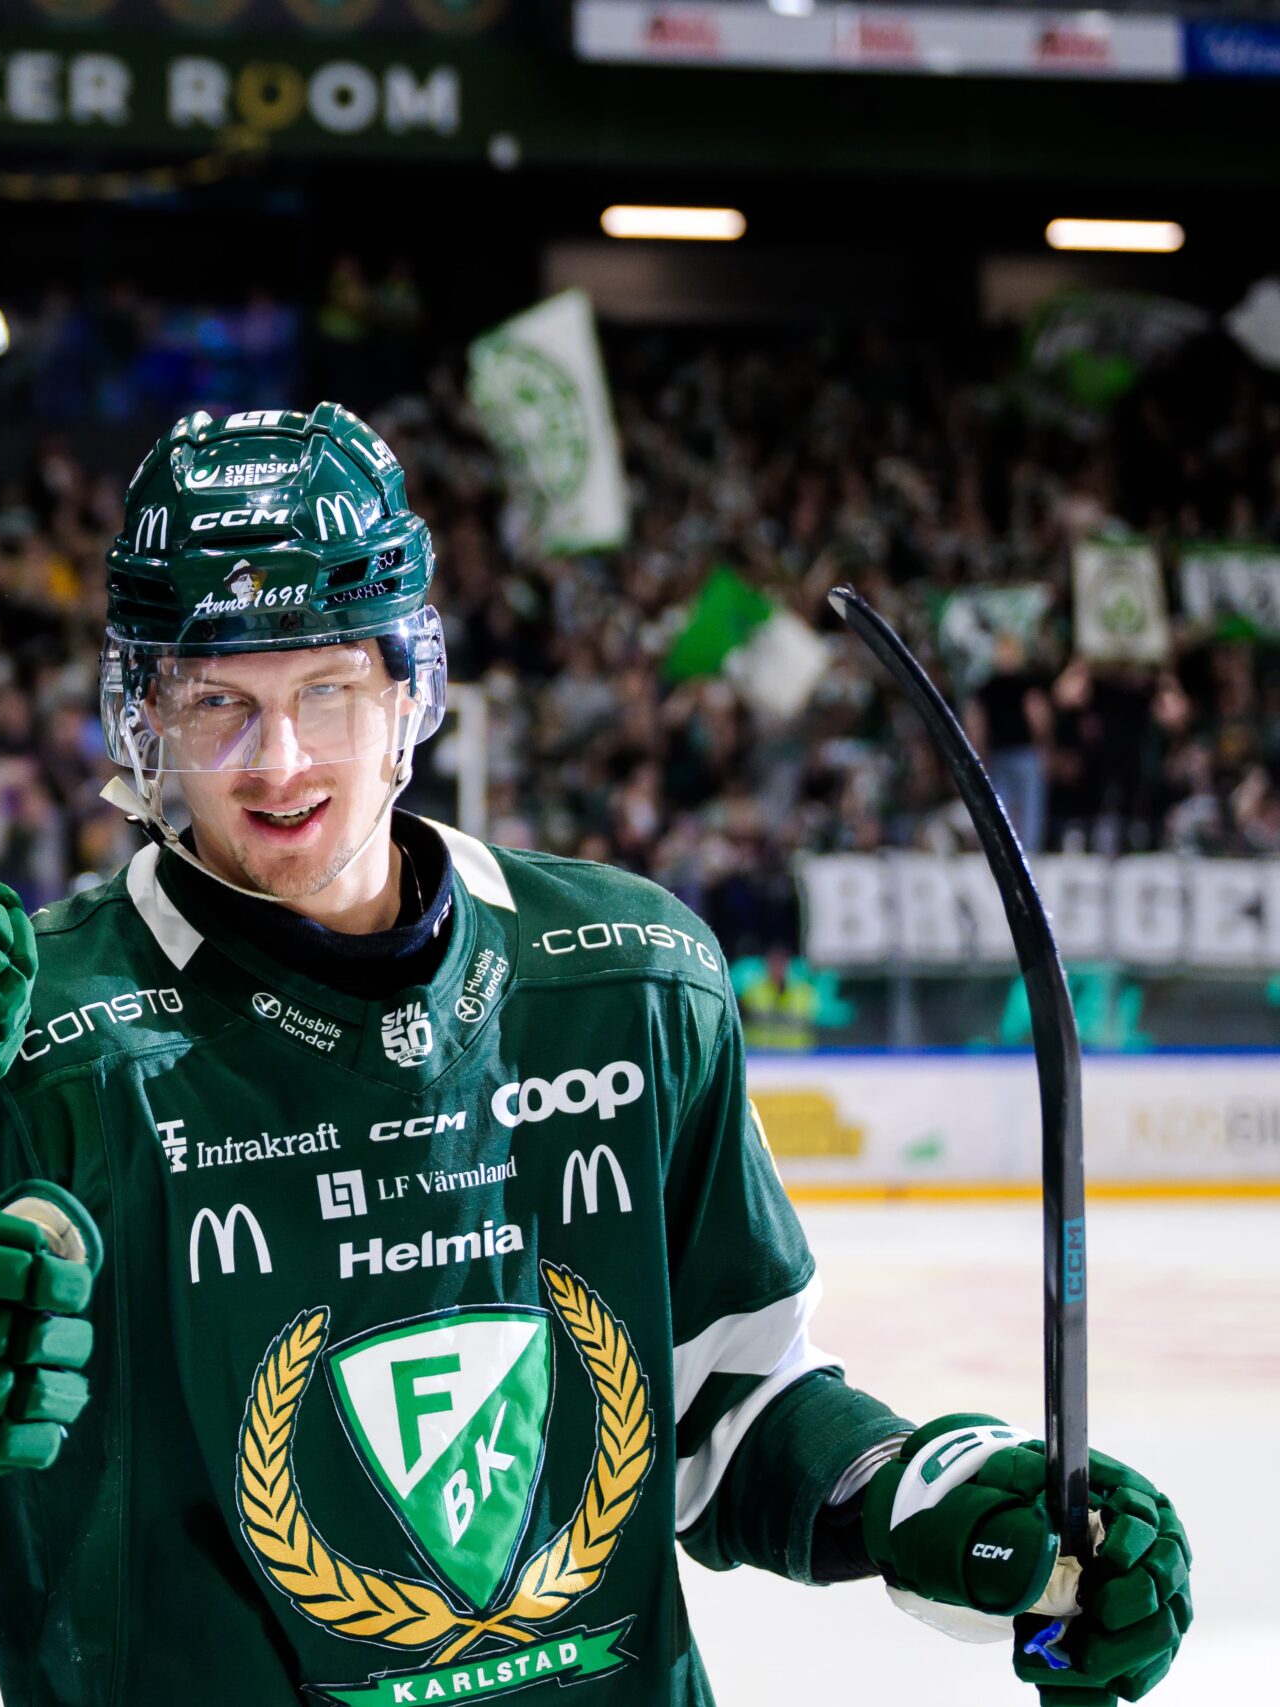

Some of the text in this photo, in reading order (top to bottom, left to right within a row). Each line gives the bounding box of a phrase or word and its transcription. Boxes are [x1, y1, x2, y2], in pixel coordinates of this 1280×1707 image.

[166, 55, 461, 136] ROOM
[223, 473, 261, 487] SPEL
[224, 462, 299, 476] SVENSKA
[190, 508, 289, 532] CCM
[192, 583, 308, 617] Anno 1698
[462, 947, 497, 994] Husbils
[477, 955, 510, 1002] landet
[279, 1020, 336, 1053] landet
[284, 1005, 343, 1040] Husbils
[381, 1001, 429, 1031] SHL
[381, 1019, 433, 1061] 50
[491, 1060, 644, 1128] coop
[196, 1122, 342, 1168] Infrakraft
[369, 1111, 467, 1142] CCM
[377, 1156, 518, 1200] LF Värmland
[339, 1219, 525, 1279] Helmia
[1067, 1223, 1084, 1299] CCM
[391, 1353, 461, 1475] F
[443, 1400, 516, 1548] BK
[971, 1543, 1014, 1561] CCM
[393, 1643, 579, 1703] KARLSTAD
